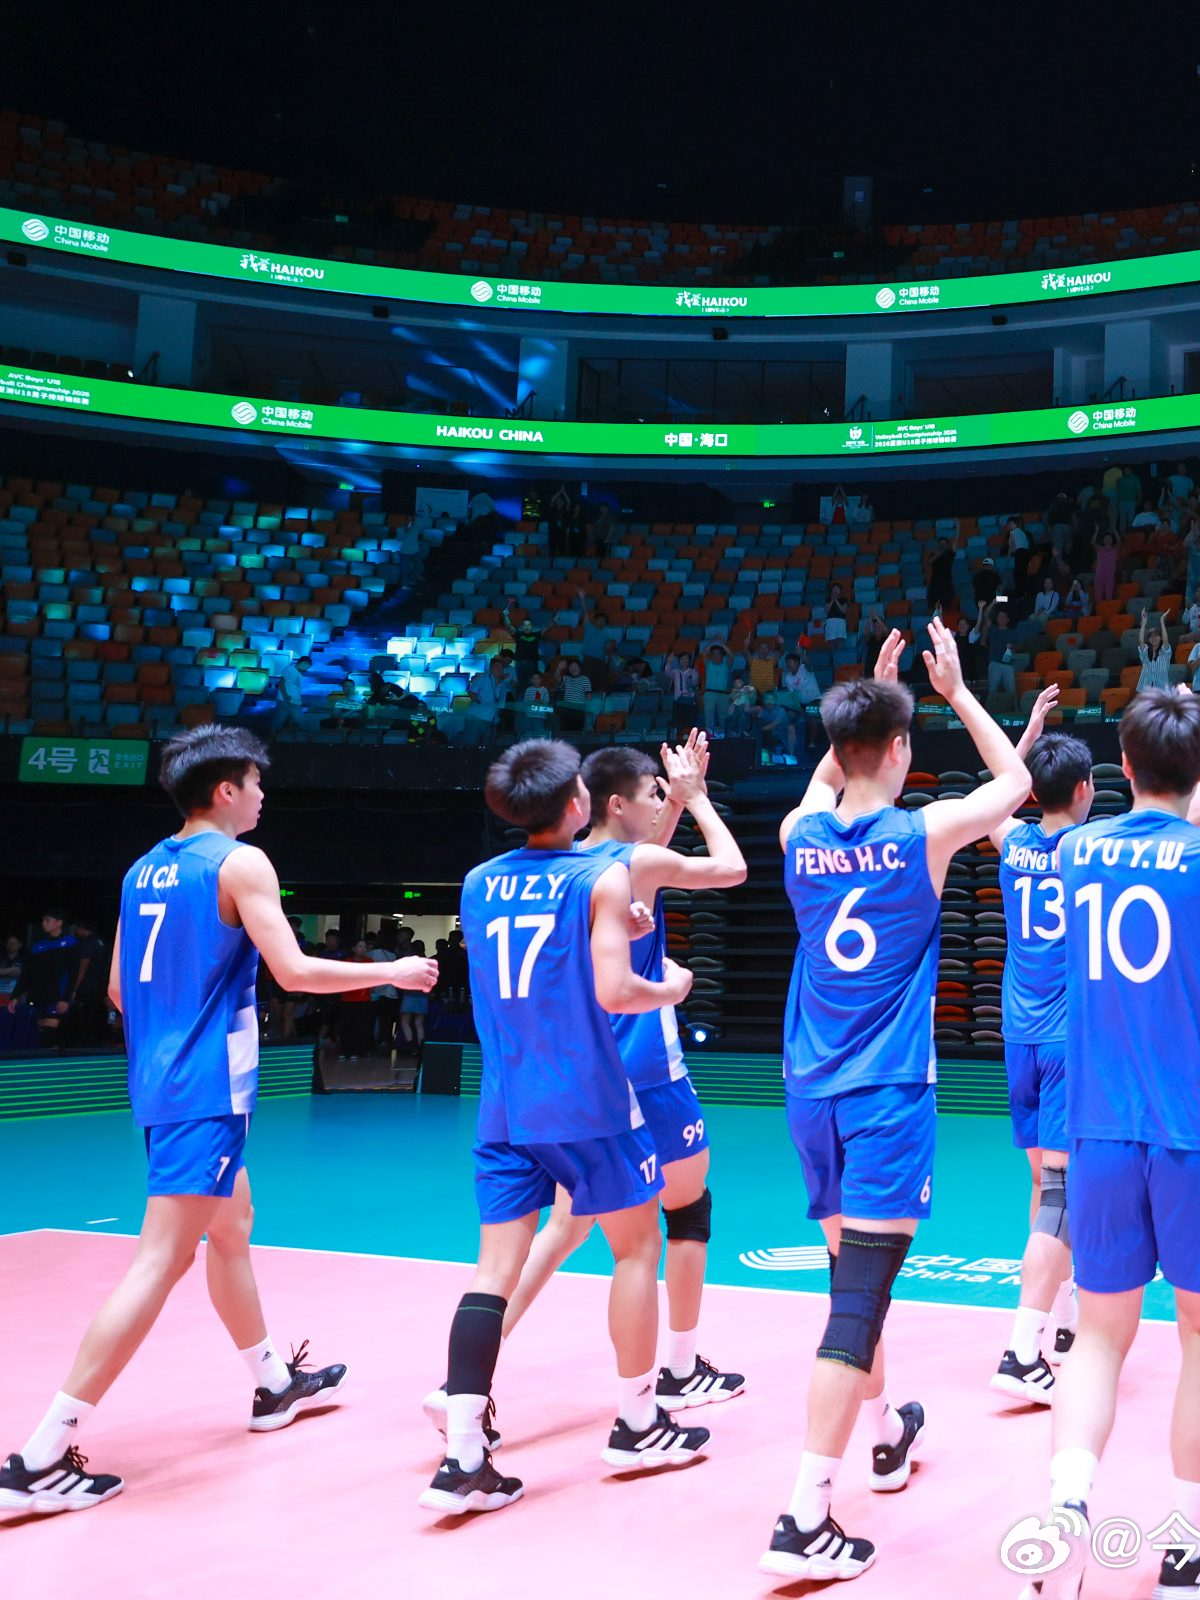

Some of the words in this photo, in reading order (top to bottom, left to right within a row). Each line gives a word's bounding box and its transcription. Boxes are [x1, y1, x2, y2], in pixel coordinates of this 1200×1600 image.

[54, 224, 110, 244] 中国移动
[54, 235, 78, 247] China
[79, 239, 109, 252] Mobile
[496, 283, 542, 297] 中国移动
[496, 294, 516, 302] China
[518, 296, 541, 305] Mobile
[898, 285, 940, 298] 中国移动
[898, 298, 917, 306] China
[918, 297, 939, 305] Mobile
[8, 372, 24, 380] AVC
[262, 405, 314, 421] 中国移动
[262, 418, 284, 427] China
[285, 420, 312, 430] Mobile
[1092, 407, 1136, 422] 中国移动
[1092, 421, 1112, 430] China
[1113, 418, 1136, 428] Mobile
[436, 426, 493, 440] HAIKOU
[499, 429, 544, 443] CHINA
[28, 747, 78, 774] 4号
[796, 848, 852, 875] FENG
[859, 842, 906, 873] H.C.
[1004, 844, 1048, 871] JIANG
[1074, 837, 1124, 866] LYU
[1128, 840, 1188, 873] Y.W.
[136, 867, 150, 889] LI
[484, 875, 517, 902] YU
[520, 874, 567, 900] Z.Y.
[1014, 876, 1066, 941] 13
[139, 902, 167, 982] 7
[824, 887, 877, 972] 6
[1074, 882, 1172, 984] 10
[486, 913, 556, 1000] 17
[682, 1118, 705, 1148] 99
[216, 1156, 230, 1182] 7
[639, 1153, 657, 1185] 17
[920, 1175, 931, 1204] 6
